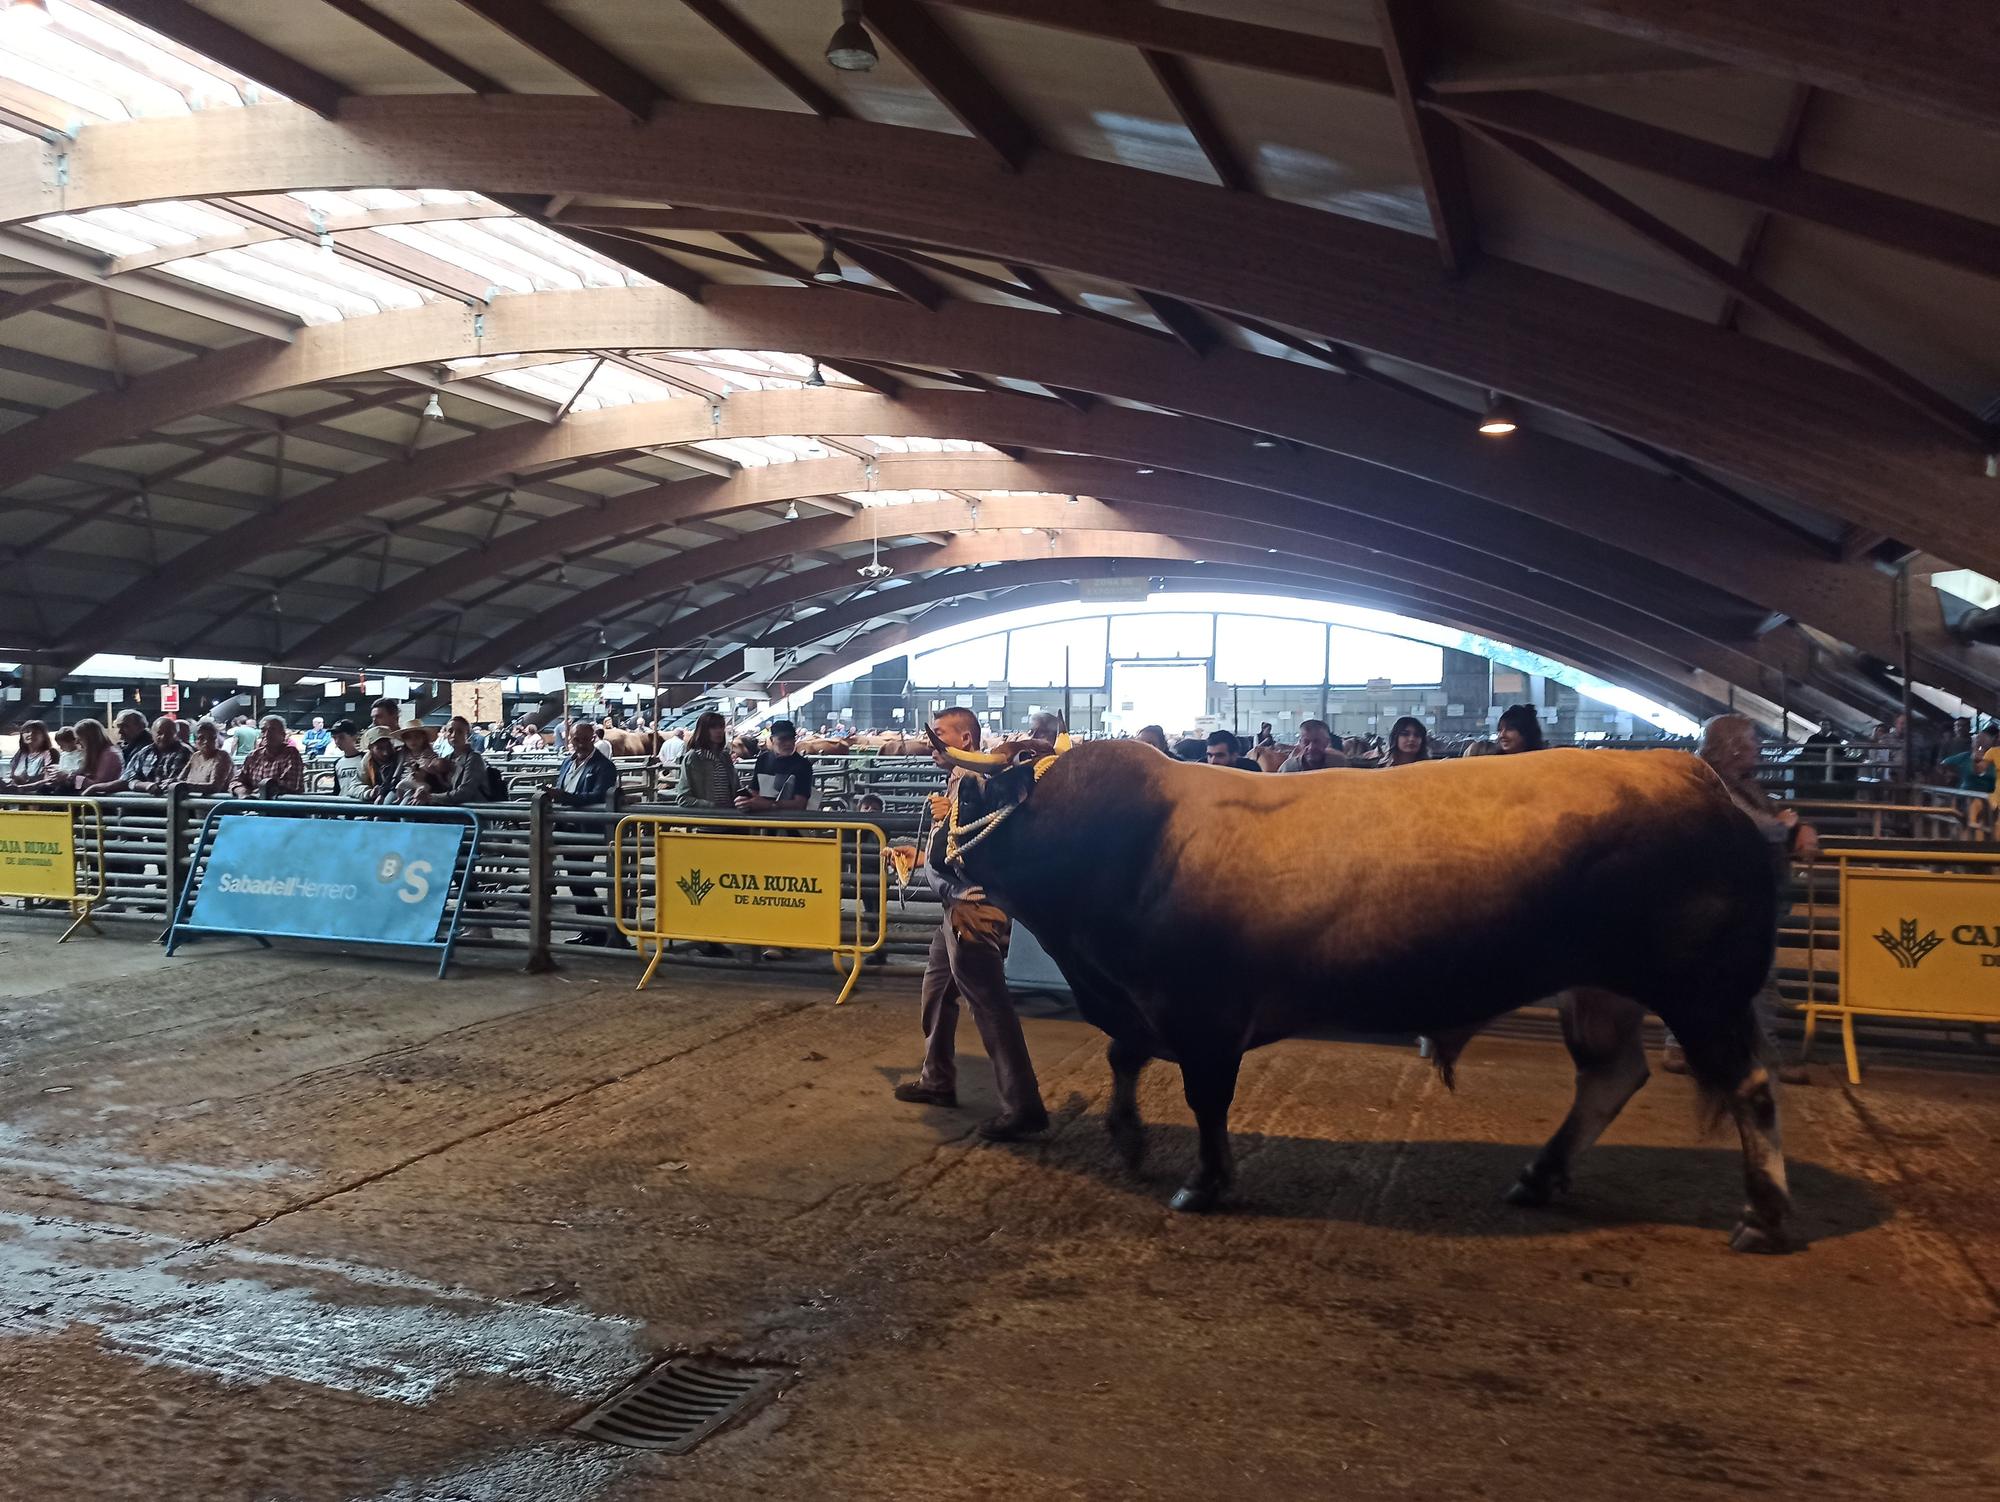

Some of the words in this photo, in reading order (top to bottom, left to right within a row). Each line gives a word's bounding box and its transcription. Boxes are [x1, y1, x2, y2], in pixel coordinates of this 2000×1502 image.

[0, 841, 21, 853] AJA
[718, 873, 760, 891] CAJA
[763, 875, 823, 894] RURAL
[735, 894, 749, 905] DE
[751, 896, 806, 909] ASTURIAS
